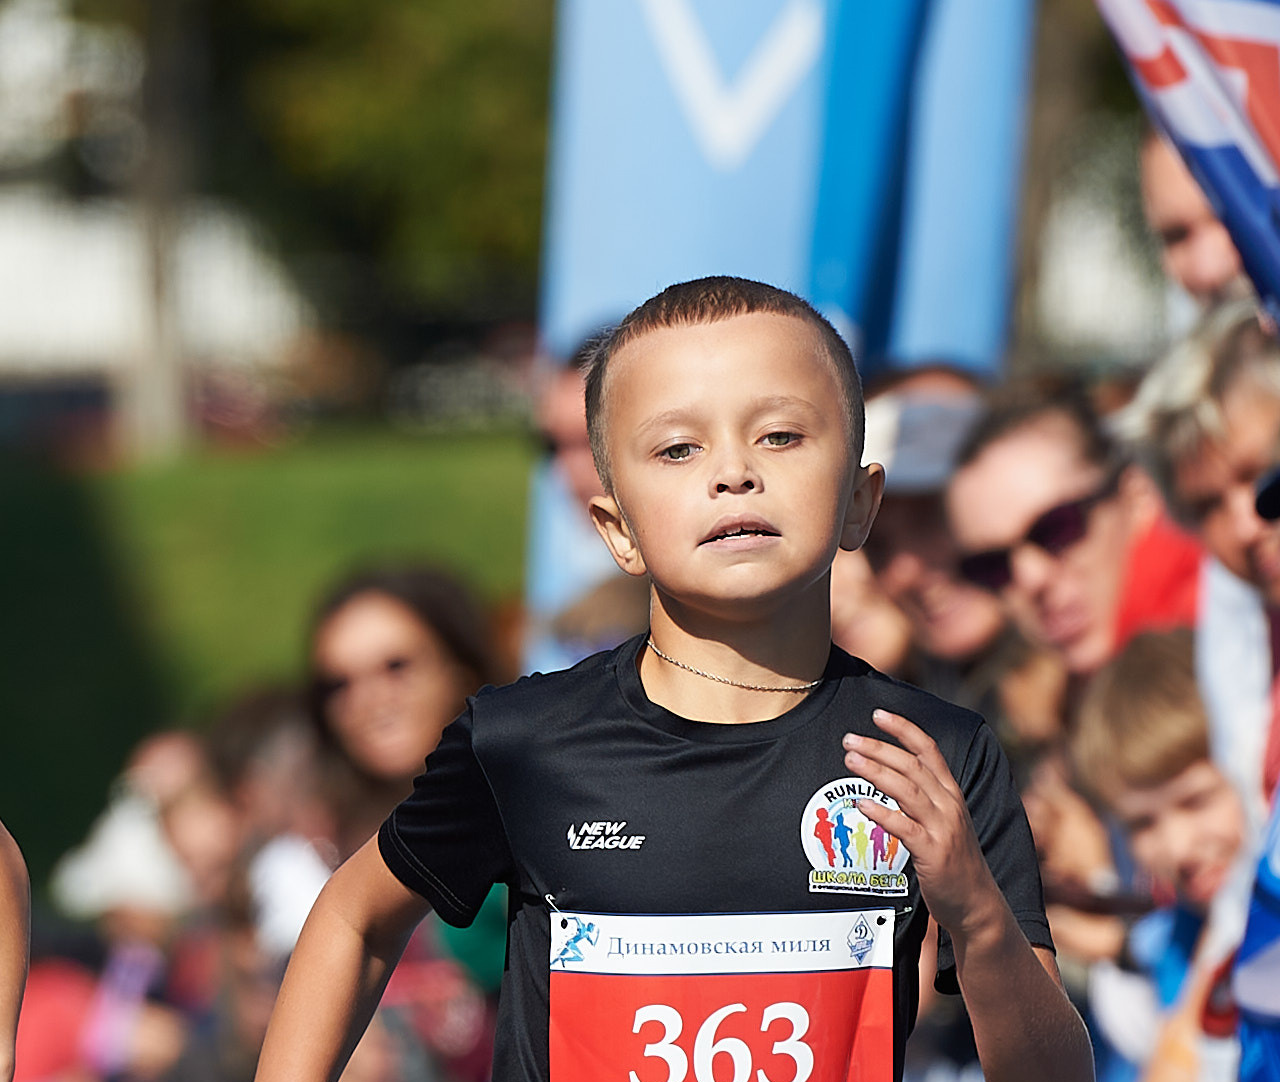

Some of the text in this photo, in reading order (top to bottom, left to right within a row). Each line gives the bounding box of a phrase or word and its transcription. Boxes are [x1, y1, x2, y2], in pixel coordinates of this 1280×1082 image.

[824, 784, 889, 803] RUNLIFE
[579, 822, 627, 835] NEW
[571, 836, 646, 849] LEAGUE
[812, 869, 907, 887] ШКОЛА БЕГА
[607, 936, 832, 959] Динамовская миля
